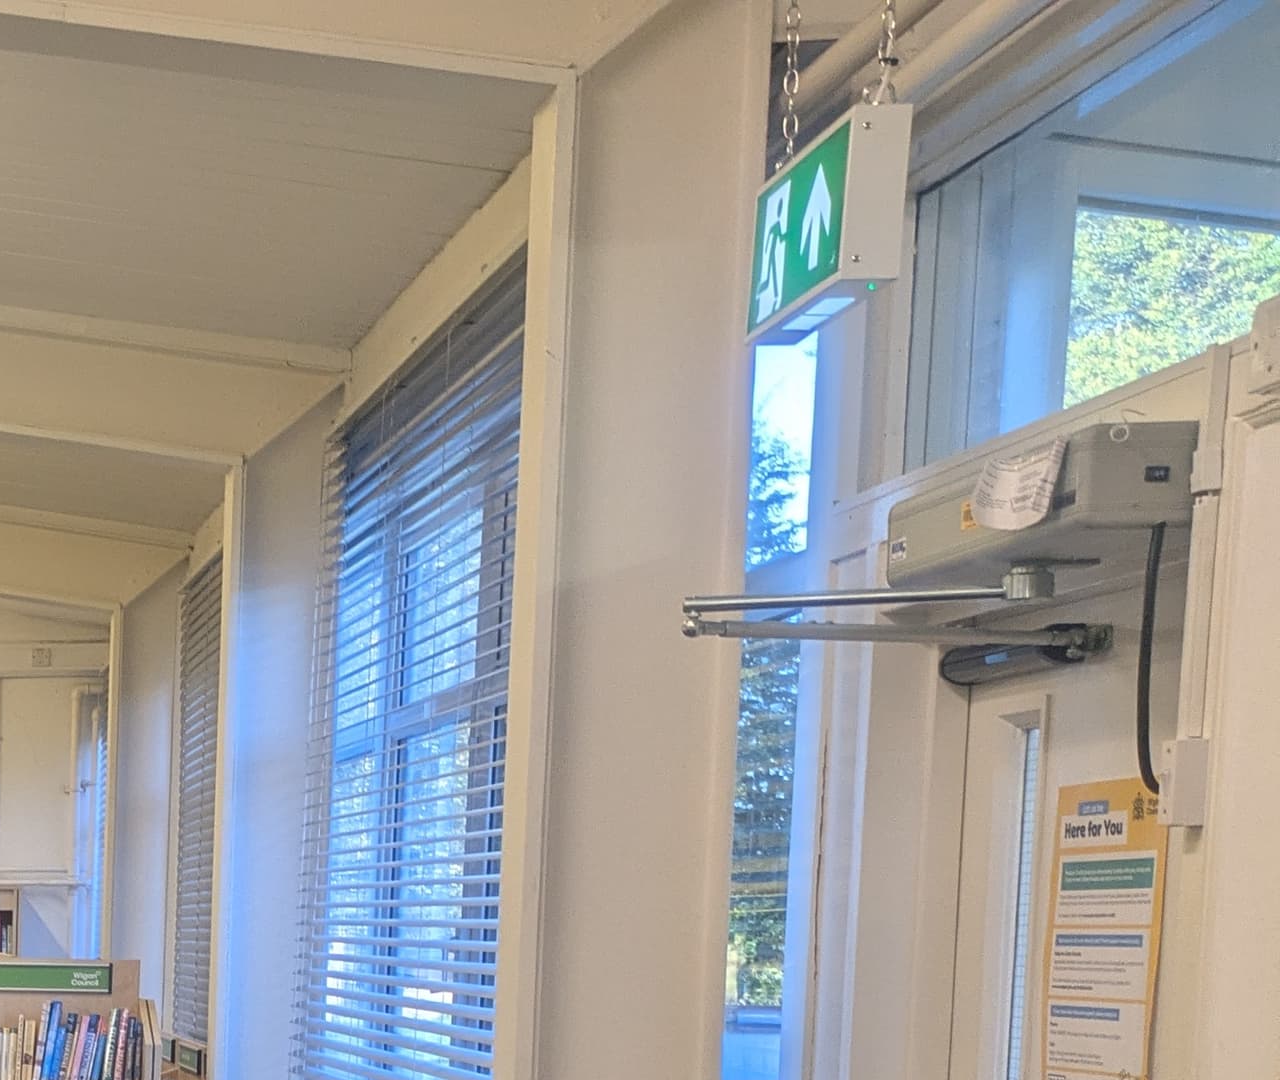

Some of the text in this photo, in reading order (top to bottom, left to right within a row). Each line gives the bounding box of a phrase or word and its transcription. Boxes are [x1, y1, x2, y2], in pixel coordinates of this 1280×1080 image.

[1064, 820, 1123, 839] Here for You
[73, 971, 97, 980] Wigan
[71, 978, 99, 987] Council
